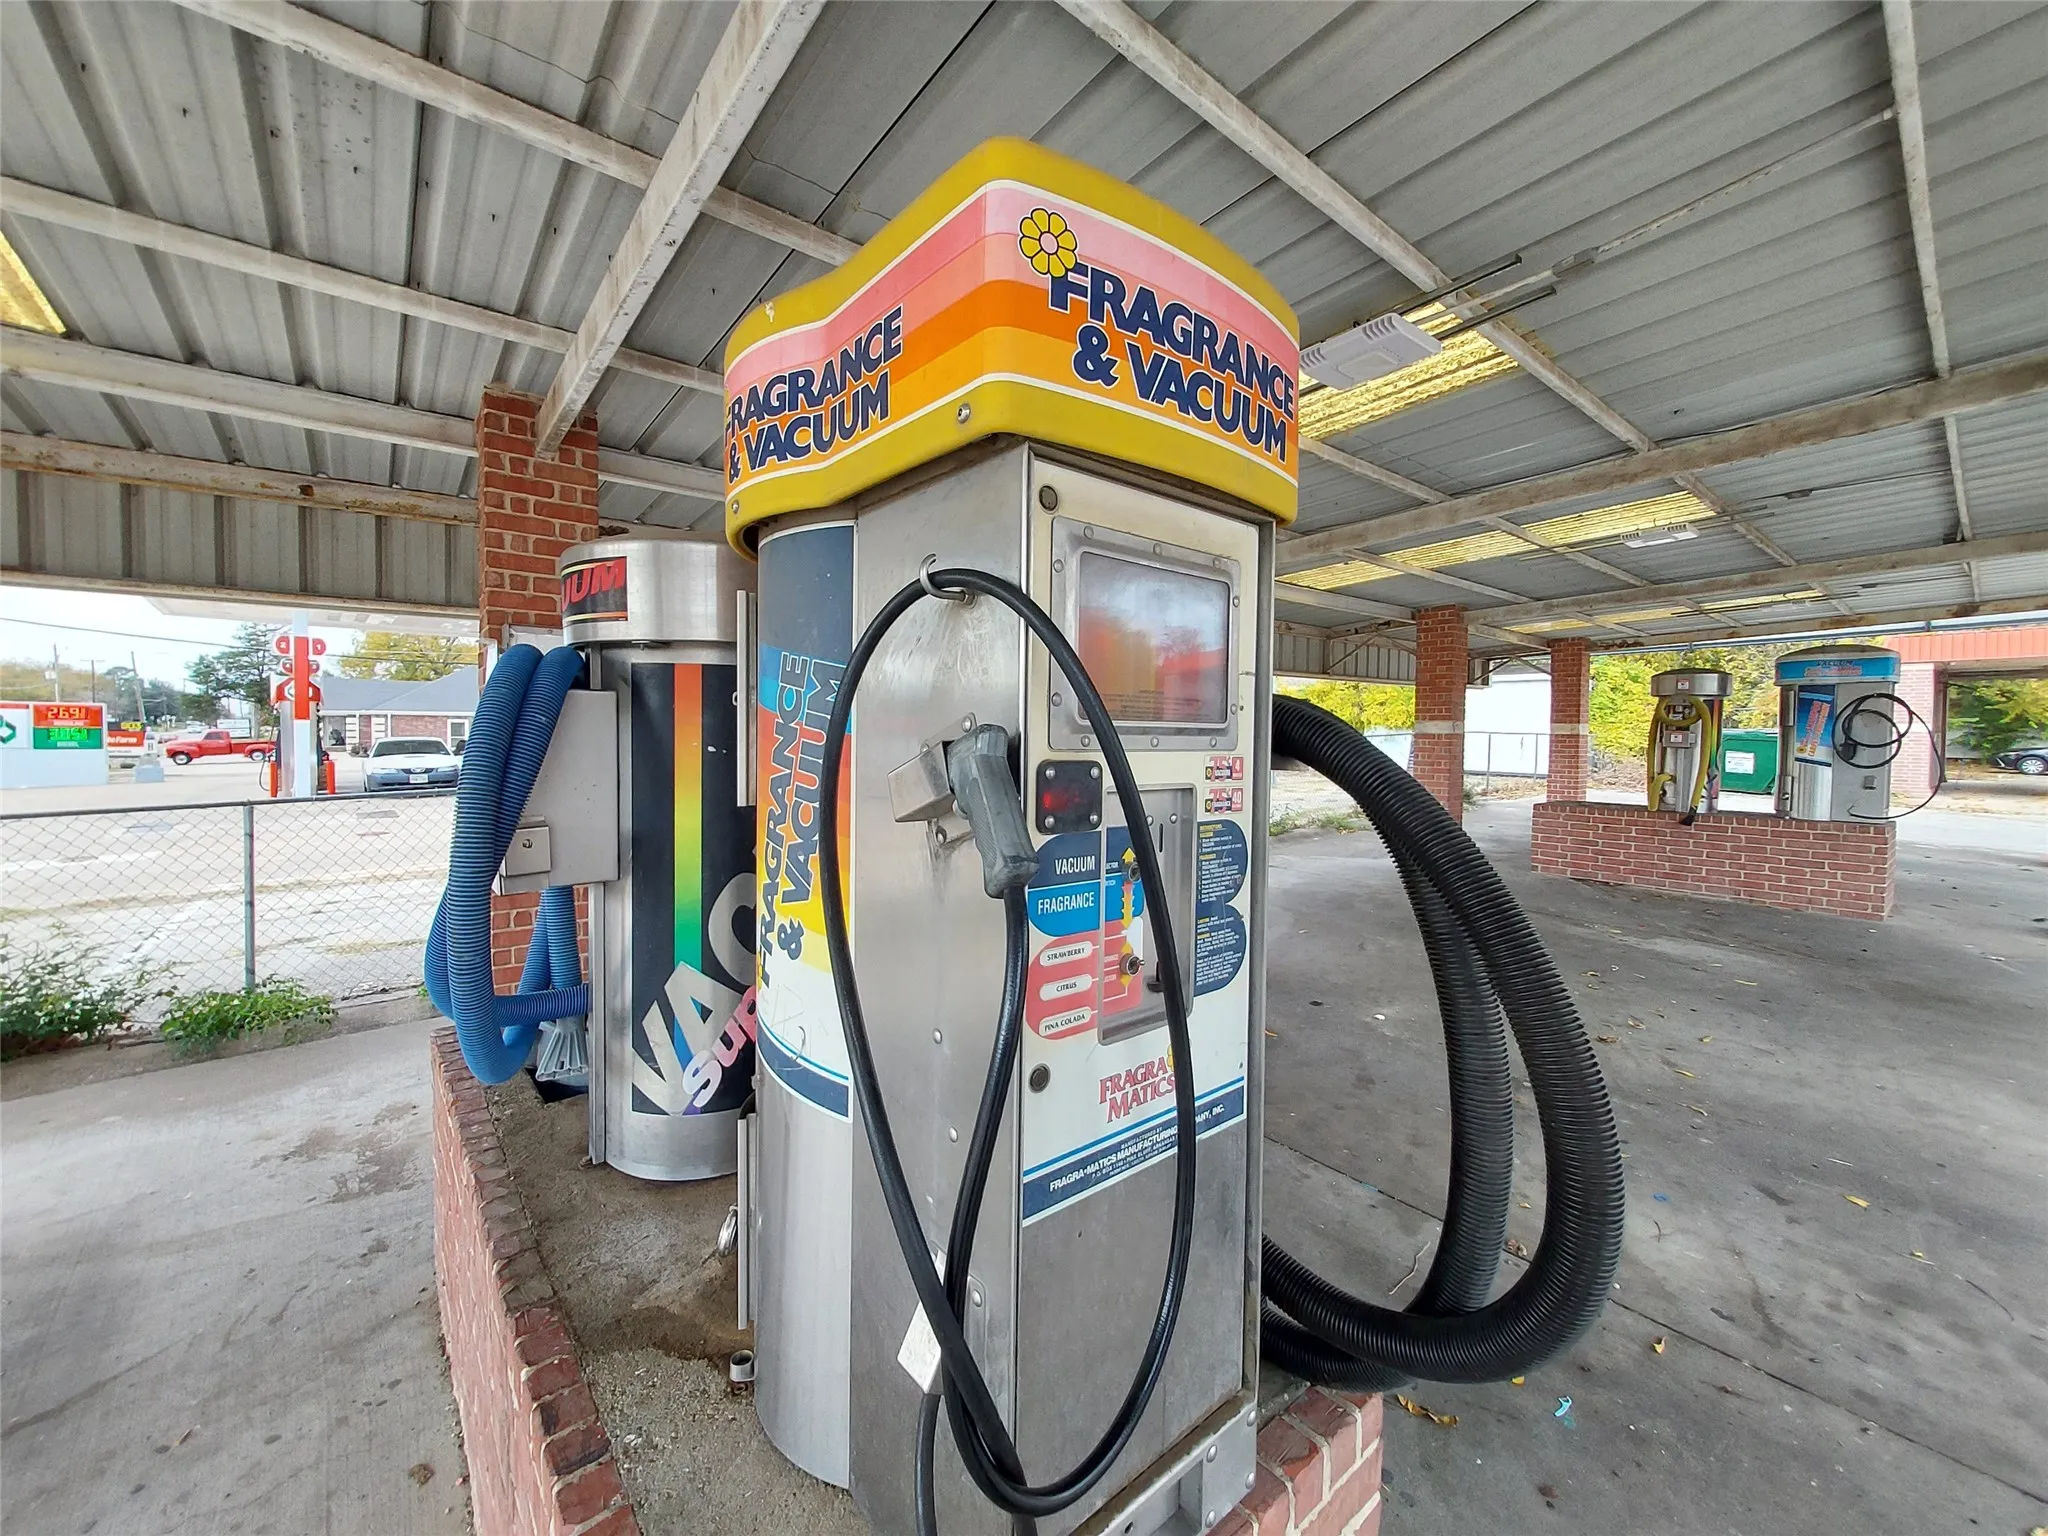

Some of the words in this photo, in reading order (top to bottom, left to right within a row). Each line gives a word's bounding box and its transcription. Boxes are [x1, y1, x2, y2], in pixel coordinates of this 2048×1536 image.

[1050, 262, 1294, 419] FRAGRANCE
[725, 305, 903, 443] FRAGRANCE
[1073, 325, 1120, 387] &
[1126, 342, 1286, 462] VACUUM
[728, 442, 741, 484] &
[743, 370, 890, 471] VACUUM
[561, 558, 626, 613] UUM
[780, 658, 848, 904] VACUUM
[1234, 758, 1241, 772] 4
[758, 651, 810, 989] FRAGRANCE
[1055, 855, 1096, 875] VACUUM
[1037, 891, 1095, 915] FRAGRANCE
[777, 915, 805, 961] &
[1046, 947, 1086, 962] STRAWBERRY
[1055, 981, 1078, 993] CITRUS
[1044, 1022, 1060, 1033] PINA
[1060, 1013, 1086, 1026] COLADA
[1098, 1056, 1169, 1105] FRAGRA
[1106, 1073, 1175, 1124] MATICS
[1117, 1125, 1178, 1160] MANUFACTURING
